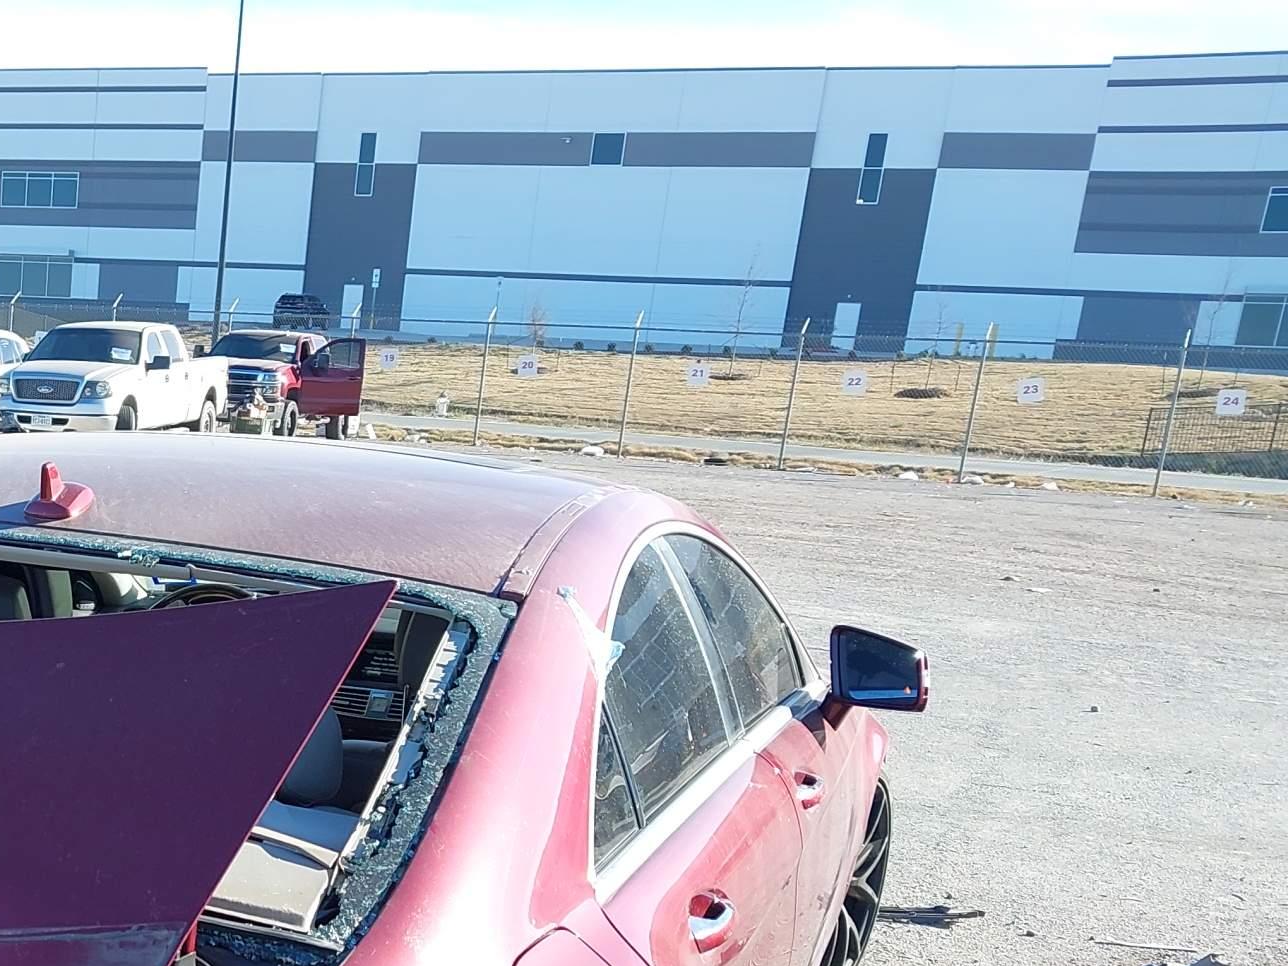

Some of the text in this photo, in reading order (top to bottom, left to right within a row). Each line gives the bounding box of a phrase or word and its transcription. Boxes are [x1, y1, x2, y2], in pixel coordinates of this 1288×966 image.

[384, 354, 395, 362] 19
[521, 361, 534, 369] 20
[692, 369, 704, 377] 21
[847, 377, 862, 386] 22
[1023, 385, 1039, 394] 23
[1222, 396, 1240, 406] 24
